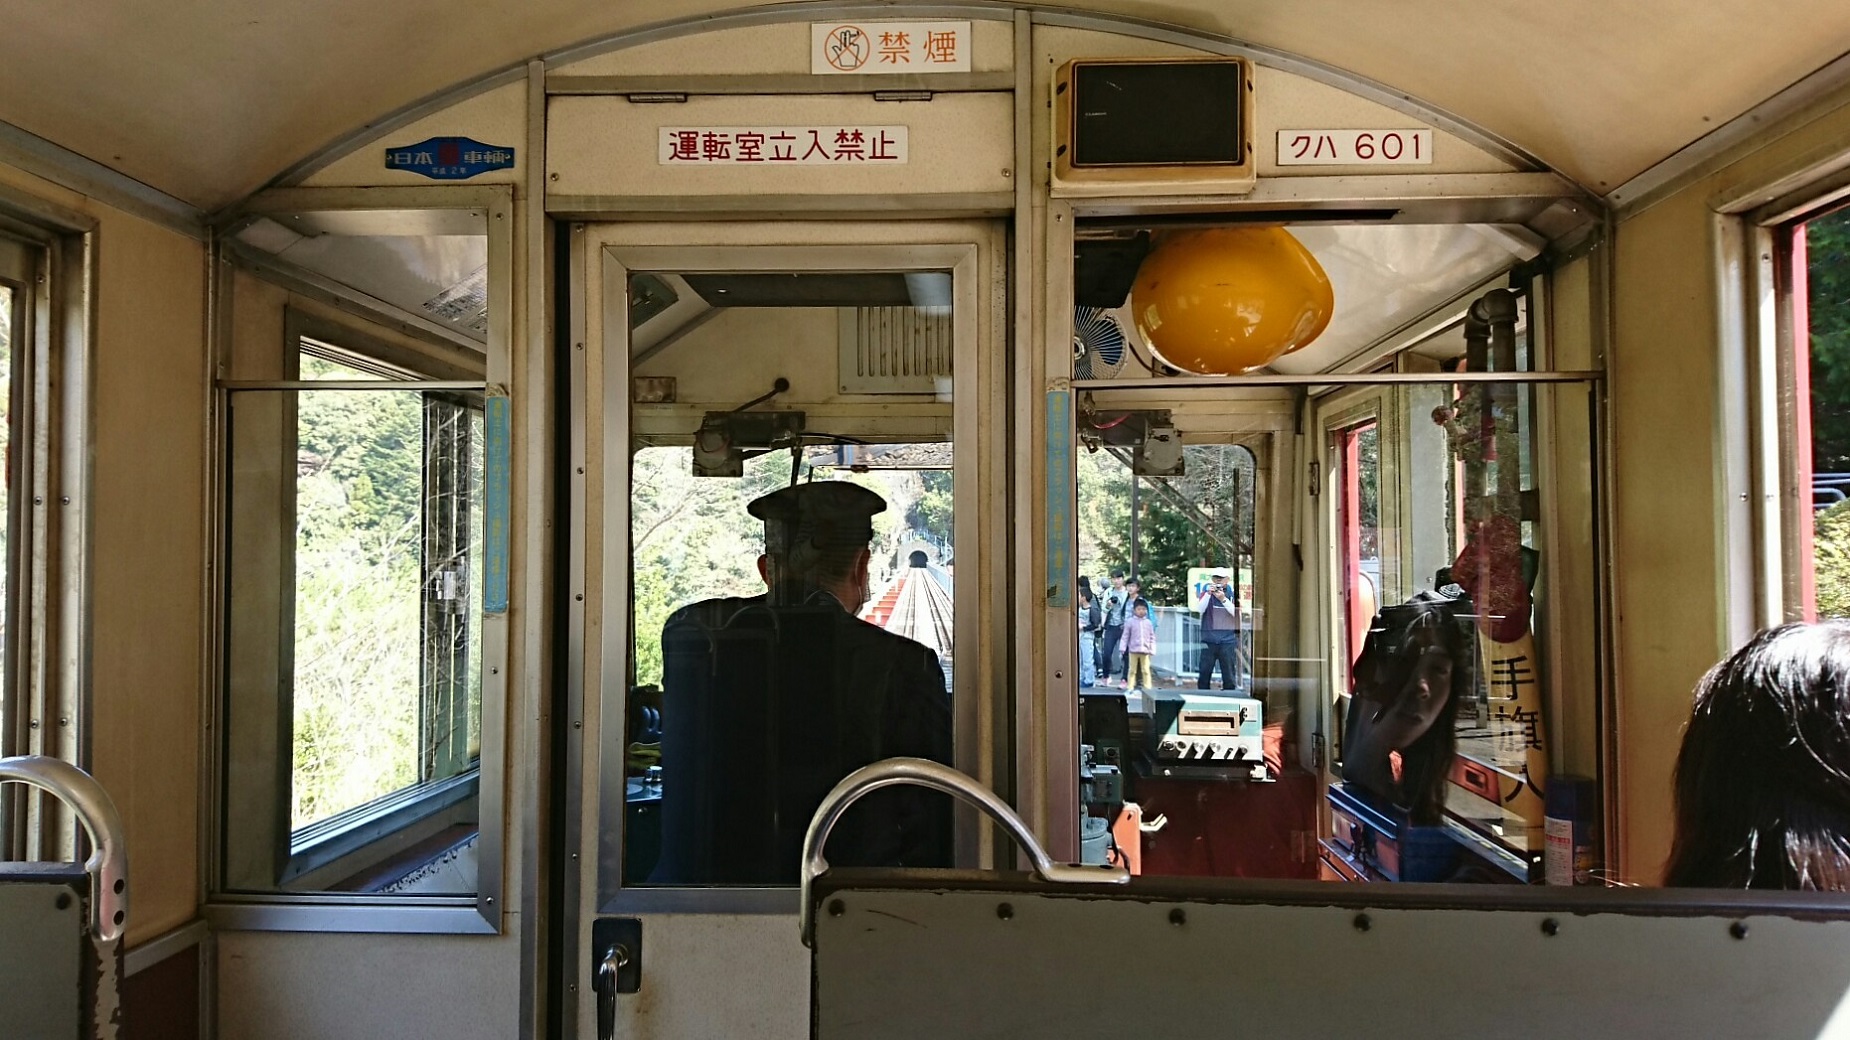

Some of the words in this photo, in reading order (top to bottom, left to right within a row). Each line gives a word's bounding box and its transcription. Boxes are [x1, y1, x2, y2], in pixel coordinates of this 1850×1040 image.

[878, 30, 958, 65] 禁煙
[394, 151, 433, 165] 日本
[669, 128, 898, 162] 運転室立入禁止
[1291, 134, 1338, 159] クハ
[1355, 133, 1421, 160] 601
